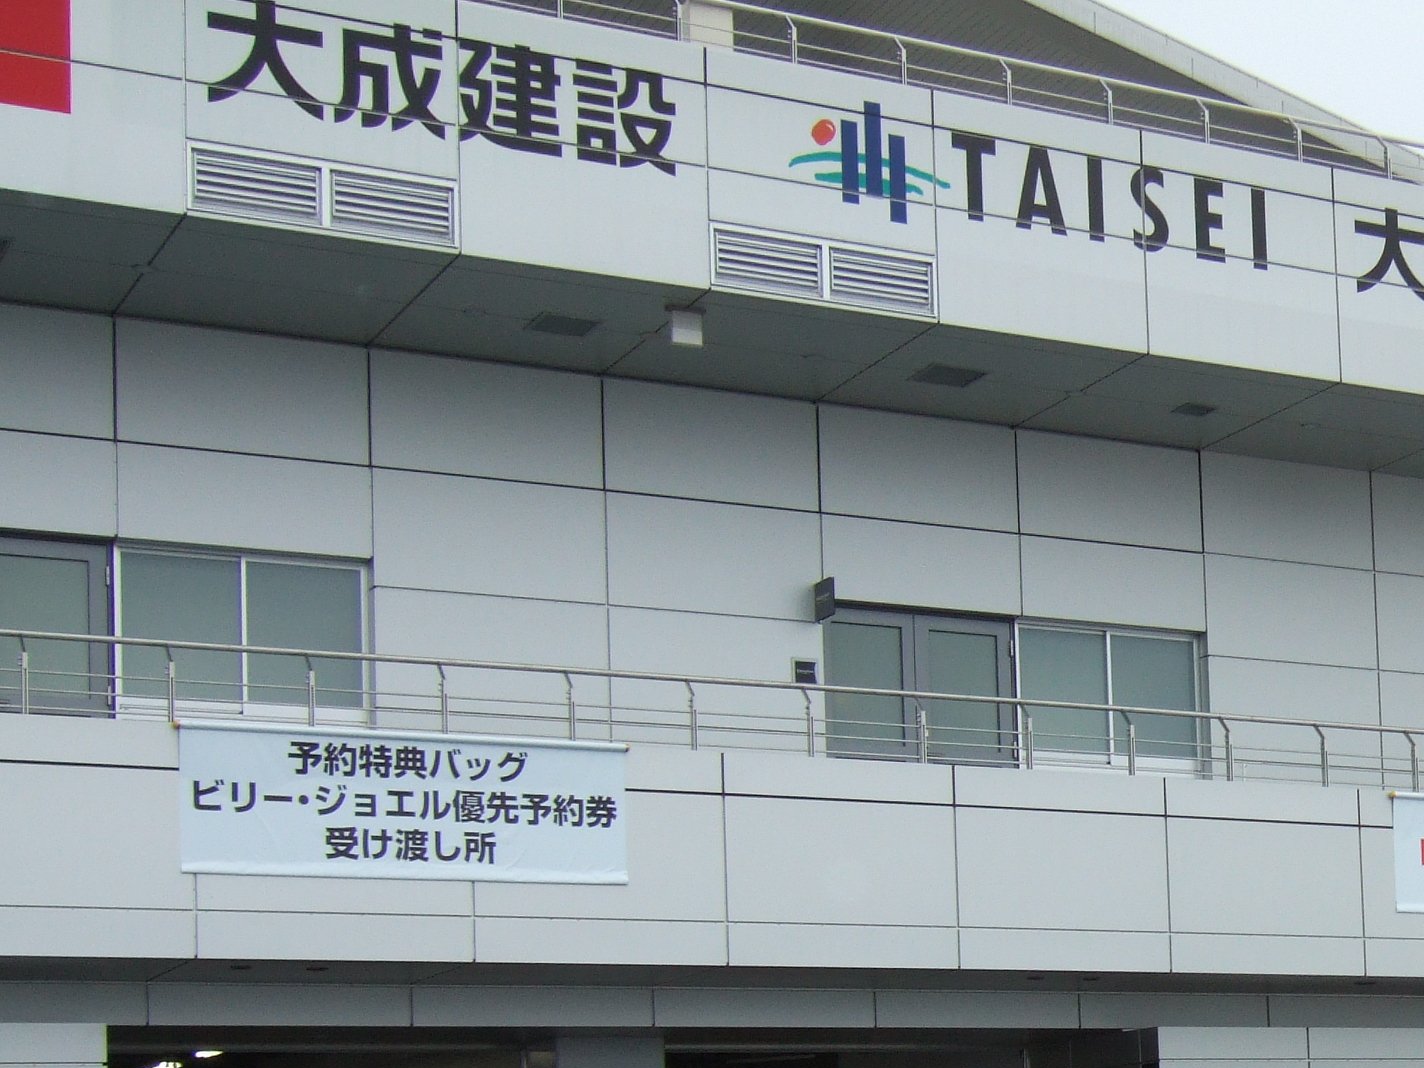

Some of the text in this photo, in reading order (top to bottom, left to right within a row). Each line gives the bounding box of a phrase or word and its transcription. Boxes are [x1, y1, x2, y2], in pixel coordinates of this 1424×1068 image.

[206, 0, 677, 176] 大成建設
[952, 131, 1268, 271] TAISEI
[288, 741, 528, 782] 予約特典バッグ
[325, 826, 496, 865] 受け渡し所
